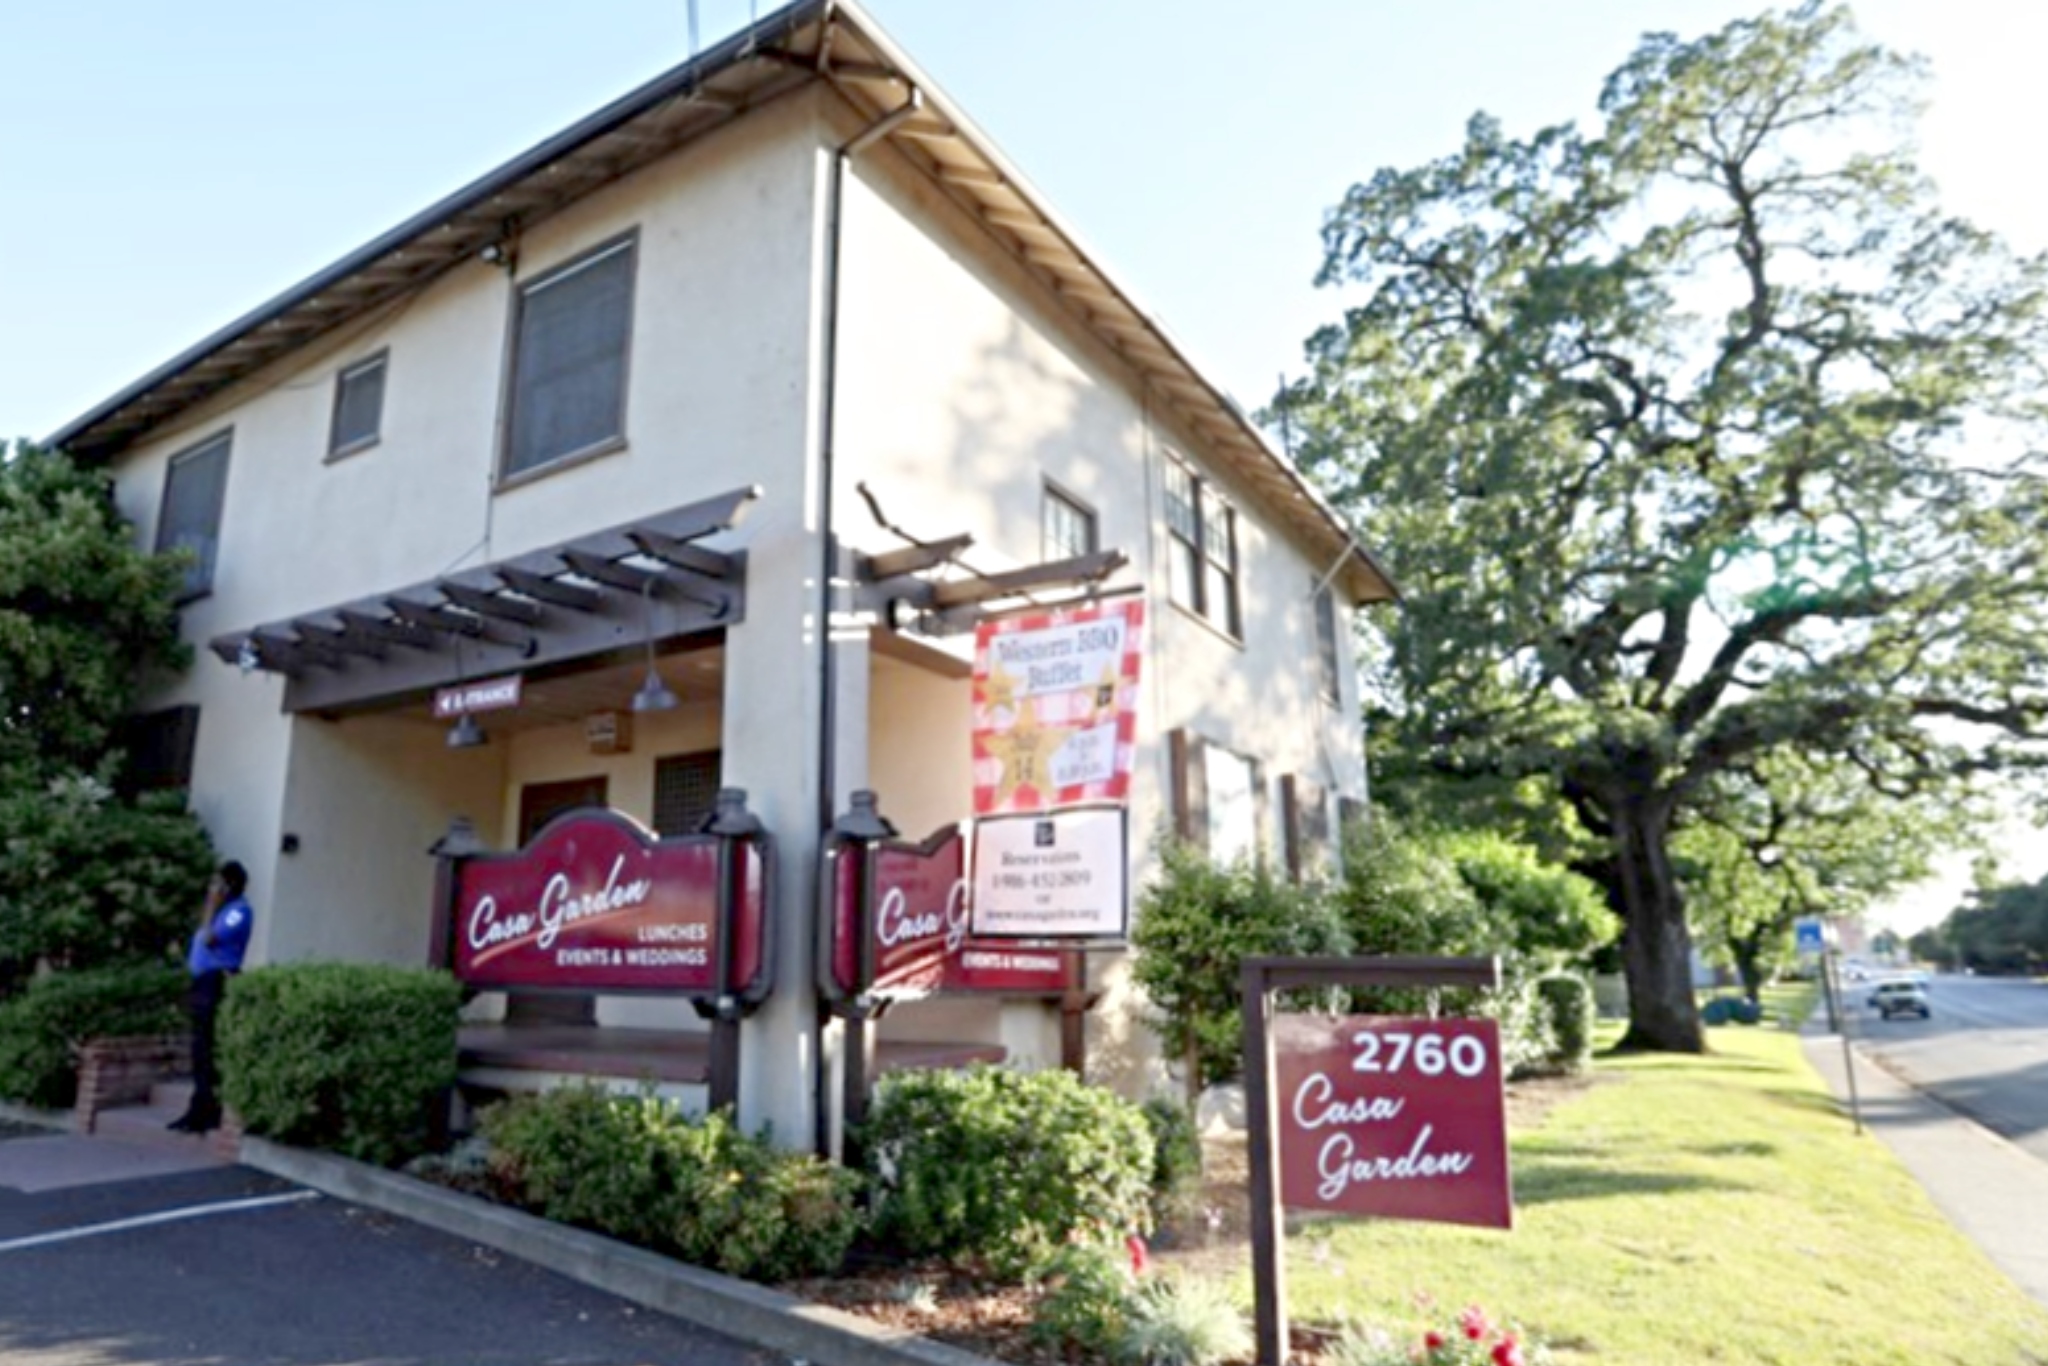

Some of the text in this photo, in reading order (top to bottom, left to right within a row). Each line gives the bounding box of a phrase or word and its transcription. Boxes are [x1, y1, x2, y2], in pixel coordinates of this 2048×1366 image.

[998, 624, 1119, 661] Western BBQ
[1028, 662, 1082, 688] Buffet
[468, 851, 651, 950] Casa Garden
[877, 887, 944, 945] Casa
[638, 923, 708, 942] LUNCHES
[556, 948, 707, 966] EVENTS & WEDDINGS
[961, 952, 1001, 968] EVENTS
[1352, 1031, 1486, 1077] 2760
[1292, 1072, 1404, 1129] Casa
[1317, 1124, 1472, 1201] Garden
